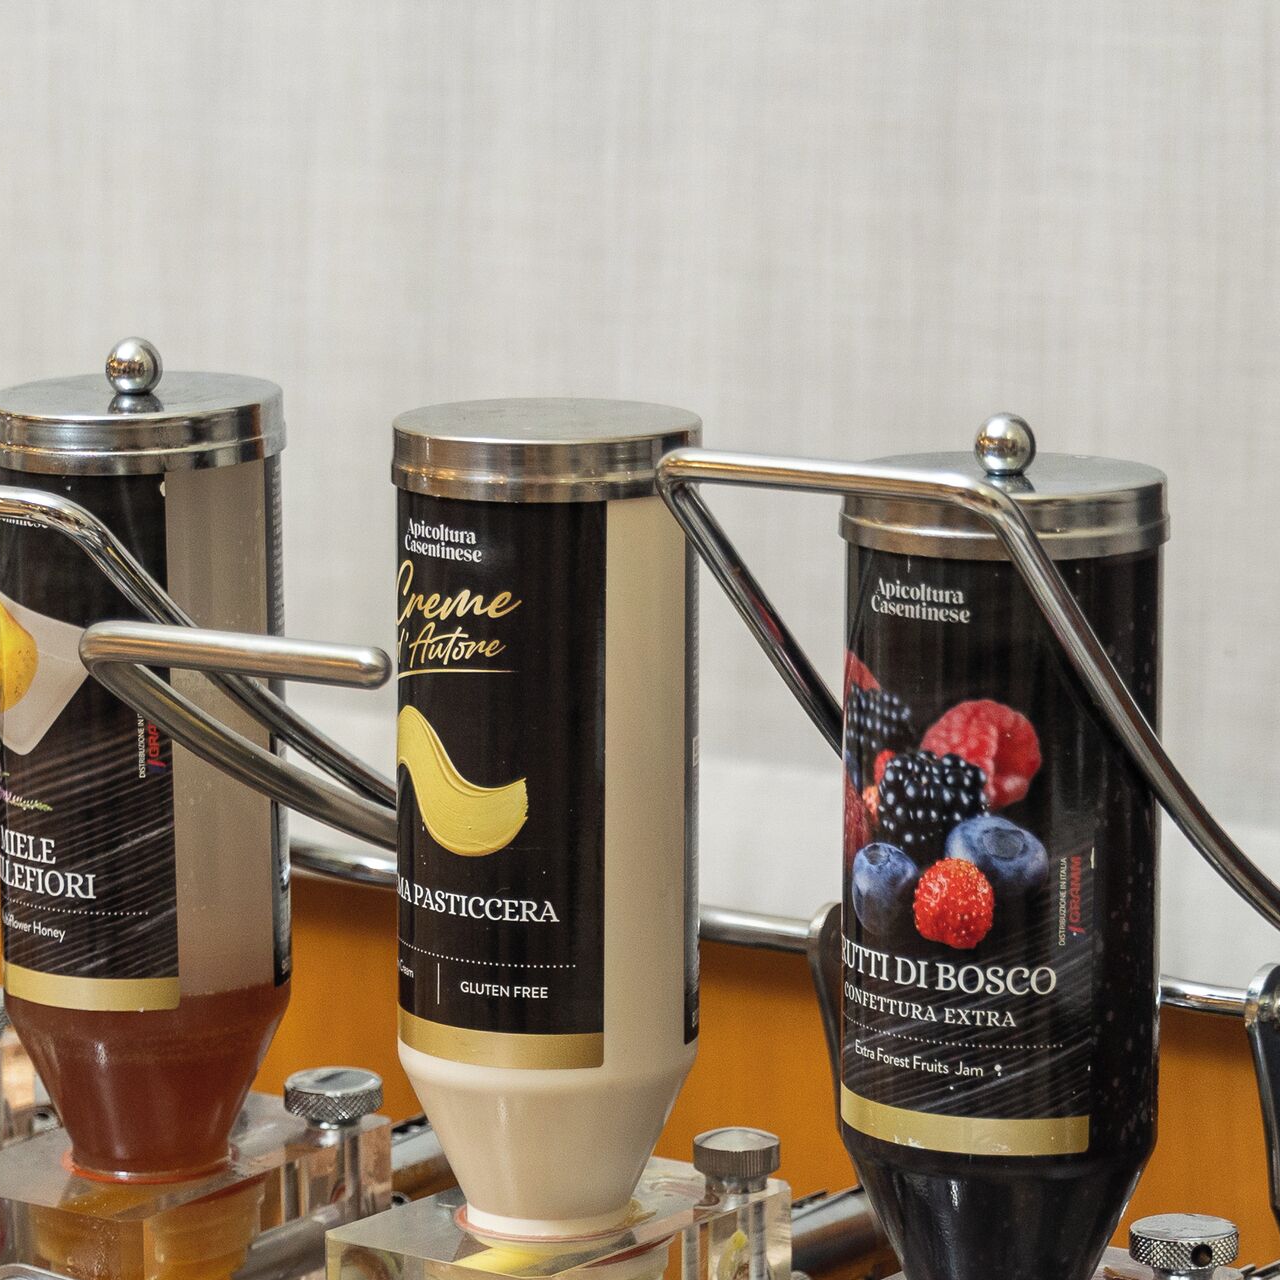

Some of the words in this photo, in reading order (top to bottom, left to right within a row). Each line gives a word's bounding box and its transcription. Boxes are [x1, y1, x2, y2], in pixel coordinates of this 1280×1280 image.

[404, 534, 483, 563] Casentinese
[406, 518, 477, 545] Apicoltura
[396, 559, 522, 626] Creme
[871, 594, 971, 624] Casentinese
[875, 577, 965, 605] Apicoltura
[137, 728, 146, 779] DISTRIBUZIONE
[413, 883, 560, 923] PASTICCERA
[1058, 890, 1067, 946] DISTRIBUZIONE
[33, 921, 66, 943] Honey
[841, 933, 890, 982] RUTTI
[894, 956, 929, 989] DI
[935, 963, 1058, 996] BOSCO
[460, 981, 510, 998] GLUTEN
[514, 986, 549, 999] FREE
[844, 981, 938, 1023] CONFETTURA
[943, 1007, 1017, 1028] EXTRA
[855, 1039, 876, 1060] Extra
[876, 1048, 910, 1069] Forest
[912, 1056, 950, 1075] Fruits
[954, 1061, 984, 1077] Jam
